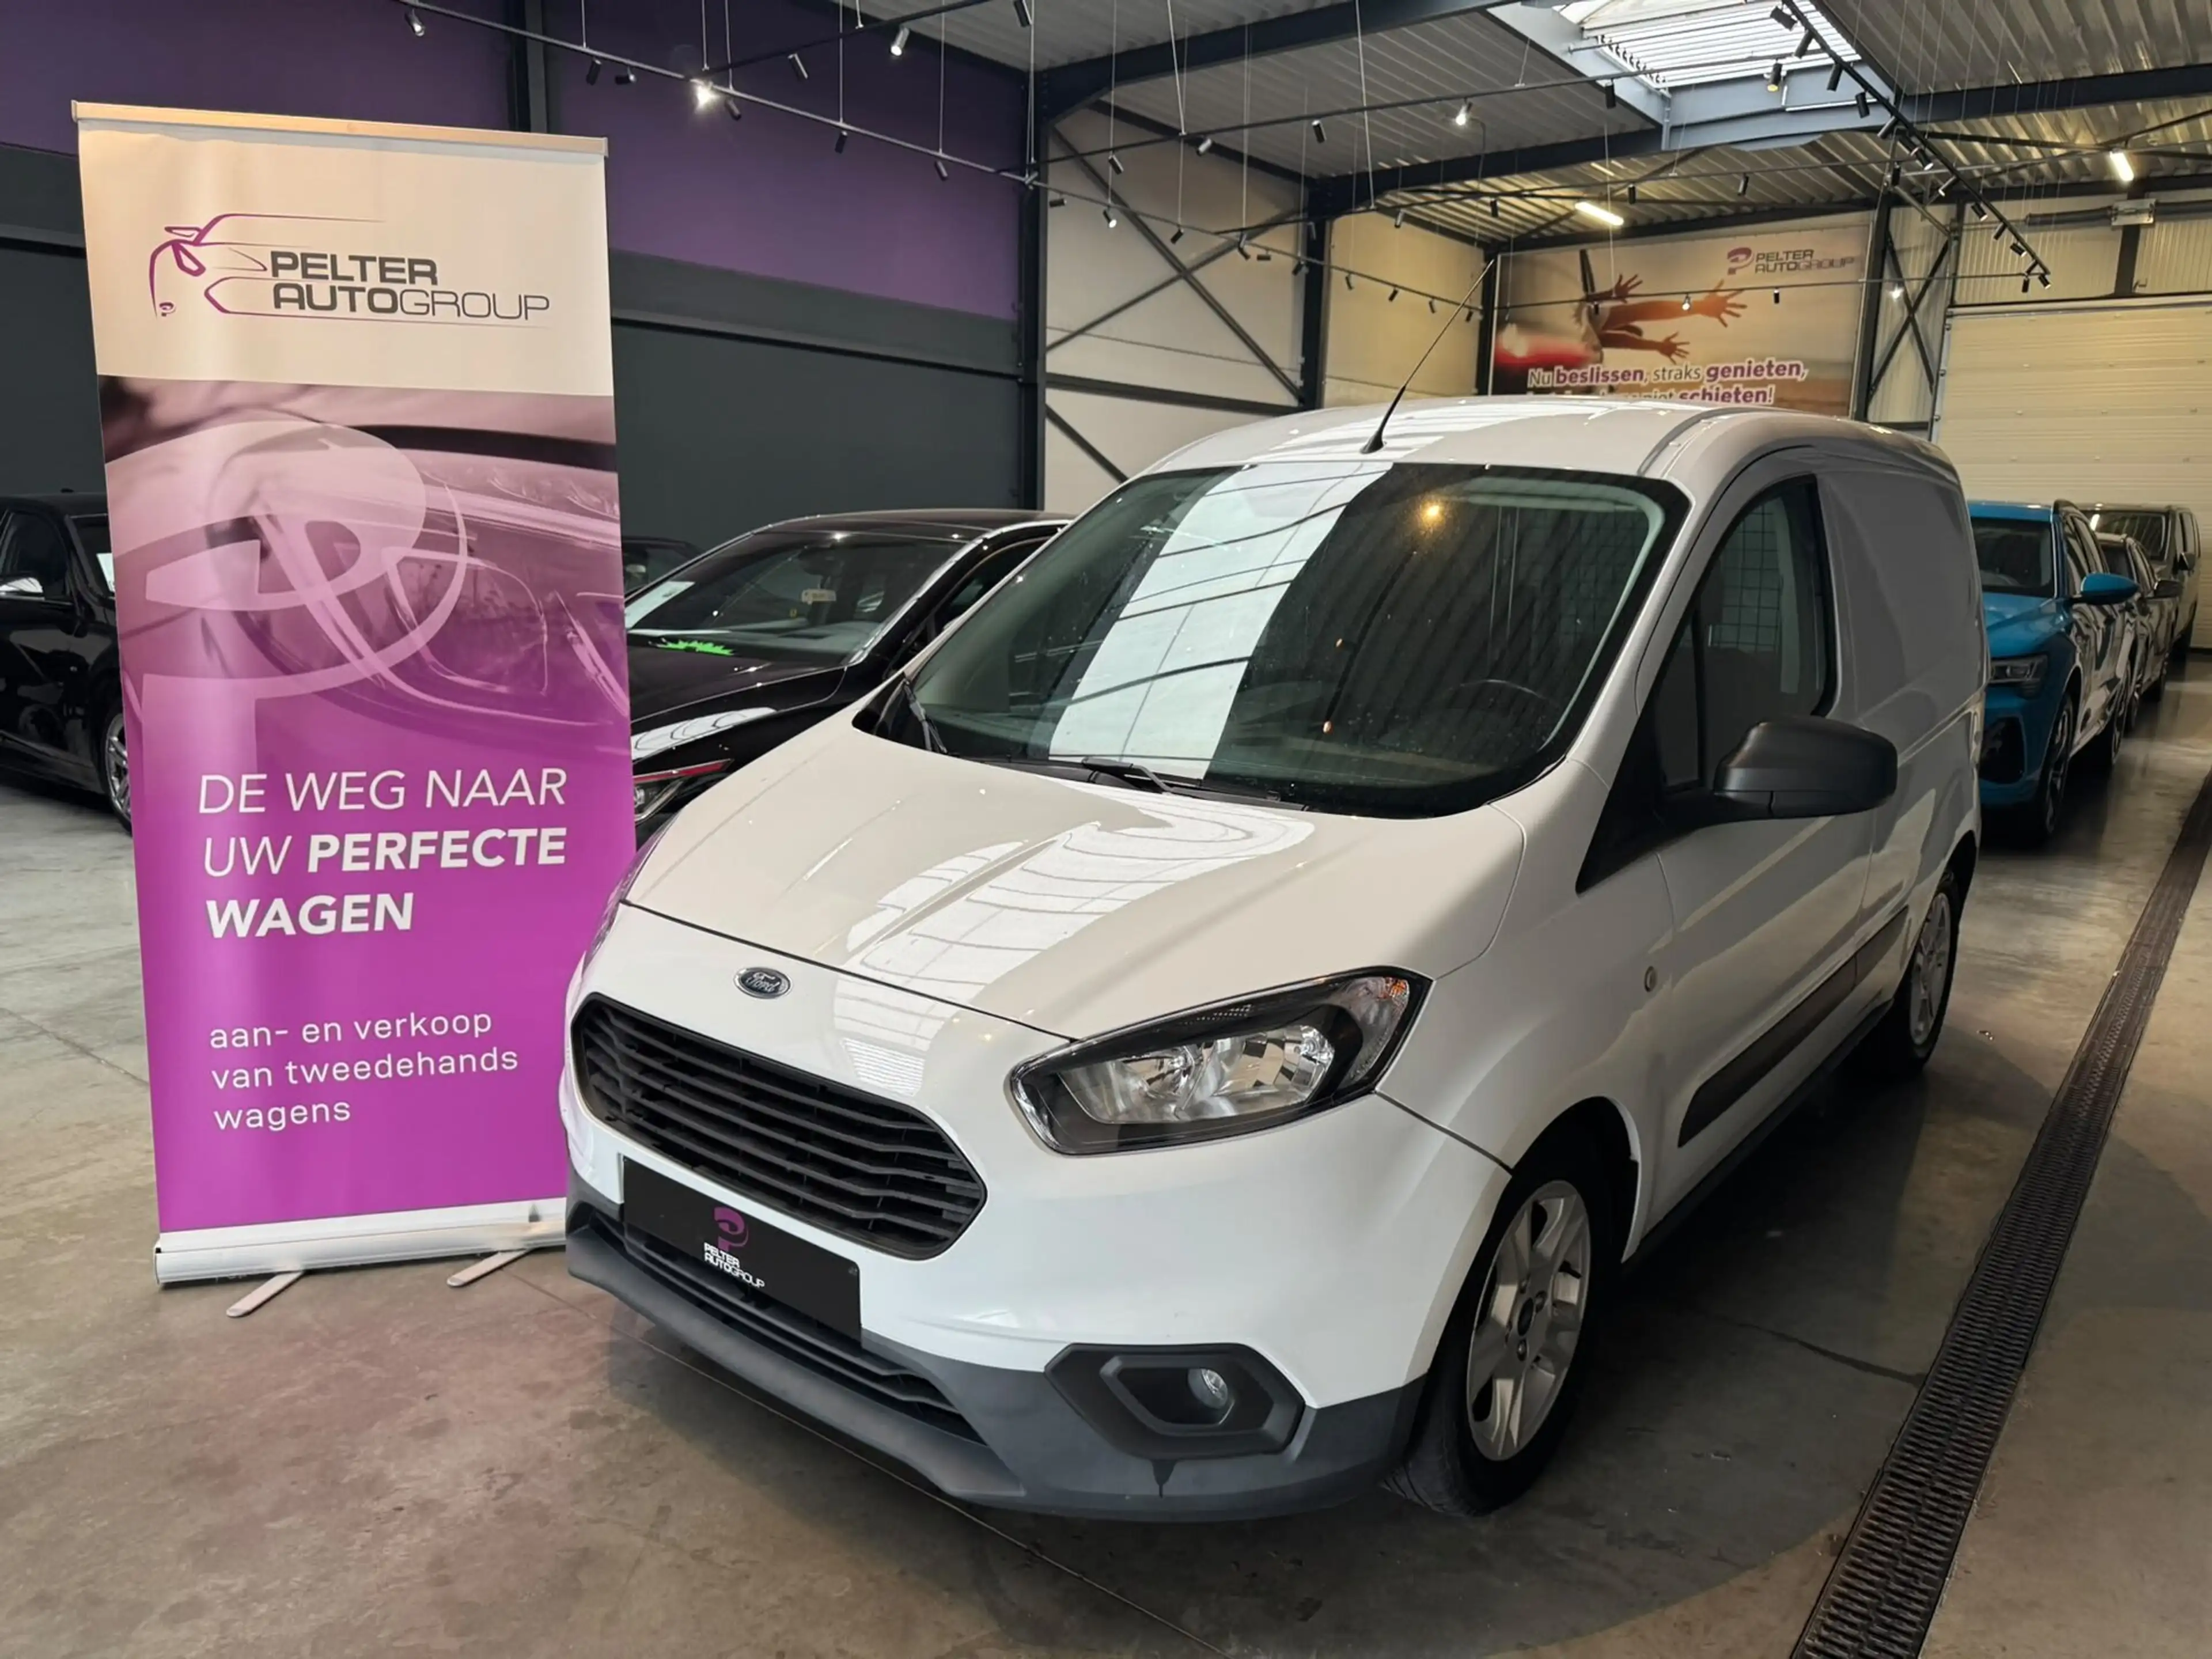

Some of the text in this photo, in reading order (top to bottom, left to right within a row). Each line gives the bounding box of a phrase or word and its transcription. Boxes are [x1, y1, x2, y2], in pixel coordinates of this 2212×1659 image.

[270, 251, 438, 285] PELTER
[1756, 249, 1815, 262] PELTER
[273, 282, 550, 321] AUTOGROUP
[1528, 369, 1552, 387] Nu
[1652, 366, 1702, 381] straks
[198, 767, 567, 814] DE WEG NAAR
[204, 827, 567, 877] UW PERFECTE
[206, 892, 414, 938] WAGEN
[210, 1012, 492, 1048] aan- en verkoop
[211, 1047, 518, 1089] van tweedehands
[213, 1101, 351, 1131] wagens
[703, 1241, 740, 1268] PELTER
[704, 1252, 766, 1289] AUTOGROUP
